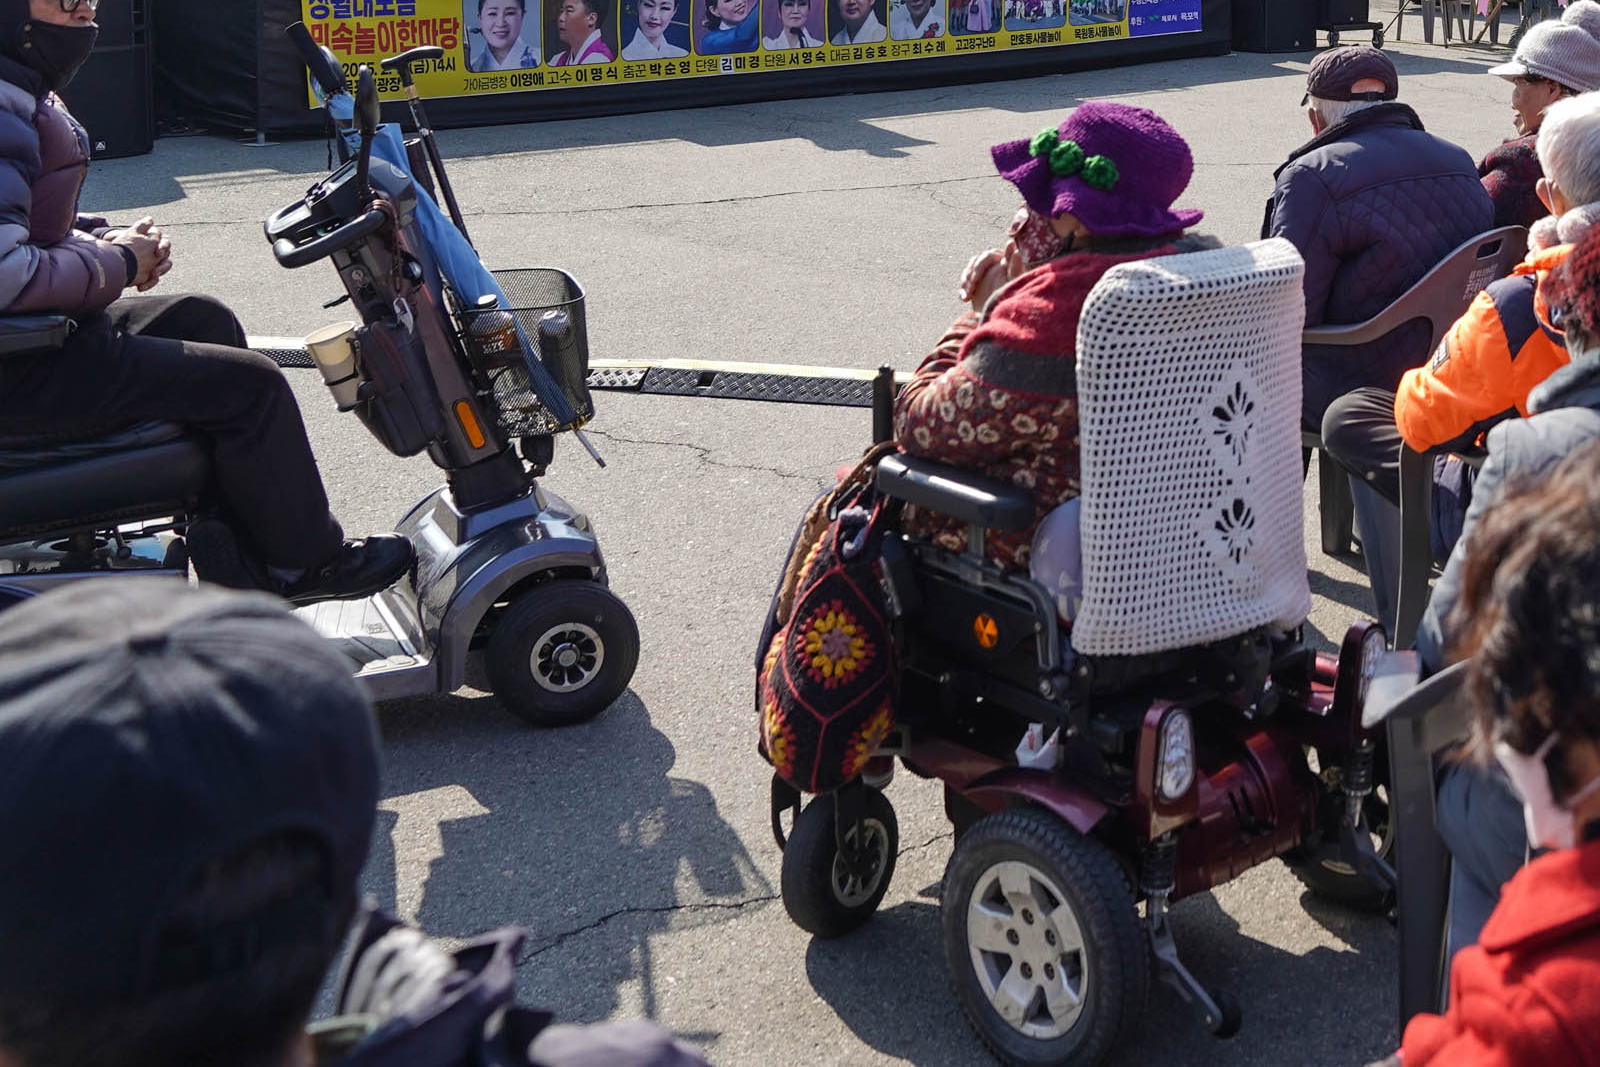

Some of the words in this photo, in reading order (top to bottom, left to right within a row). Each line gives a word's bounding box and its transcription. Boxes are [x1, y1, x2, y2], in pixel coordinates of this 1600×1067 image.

[432, 56, 456, 73] 14시
[510, 72, 544, 87] 이영애
[547, 70, 572, 84] 고수
[695, 58, 718, 73] 단원
[764, 53, 786, 68] 단원
[830, 49, 851, 62] 대금
